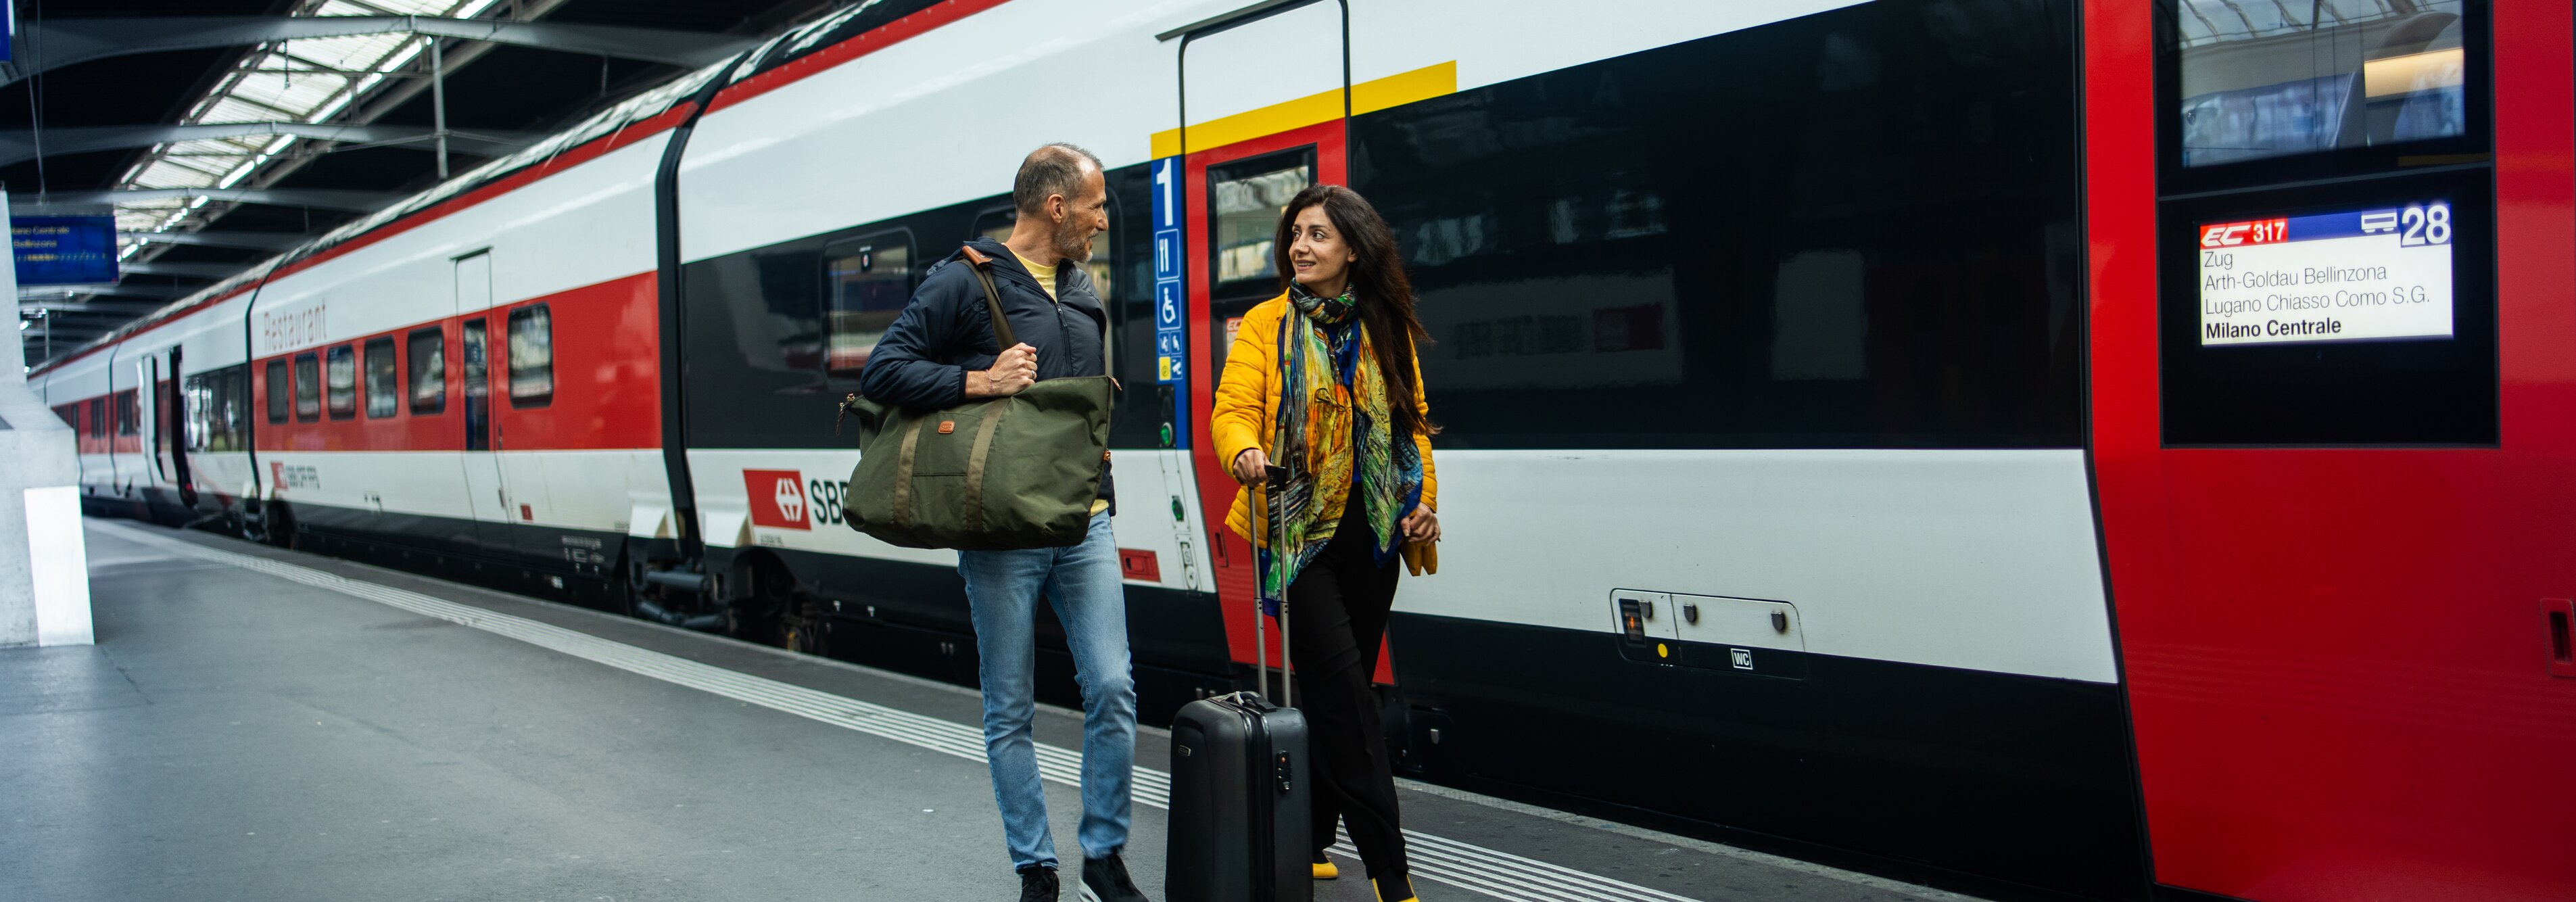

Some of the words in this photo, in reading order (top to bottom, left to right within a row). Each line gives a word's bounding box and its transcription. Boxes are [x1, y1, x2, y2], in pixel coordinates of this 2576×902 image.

[1156, 158, 1173, 227] 1
[2201, 224, 2251, 247] EC
[2253, 222, 2285, 243] 317
[2401, 205, 2451, 246] 28
[2204, 251, 2233, 270] Zug
[2204, 270, 2299, 291] Arth-Goldau
[2304, 266, 2387, 285] Bellinzona
[2205, 298, 2262, 318] Lugano
[2266, 293, 2330, 311] Chiasso
[2335, 289, 2387, 308] Como
[2392, 285, 2430, 304] S.G.
[264, 298, 327, 352] Restaurant
[2206, 322, 2261, 339] Milano
[2266, 317, 2341, 337] Centrale
[1734, 652, 1750, 666] WC
